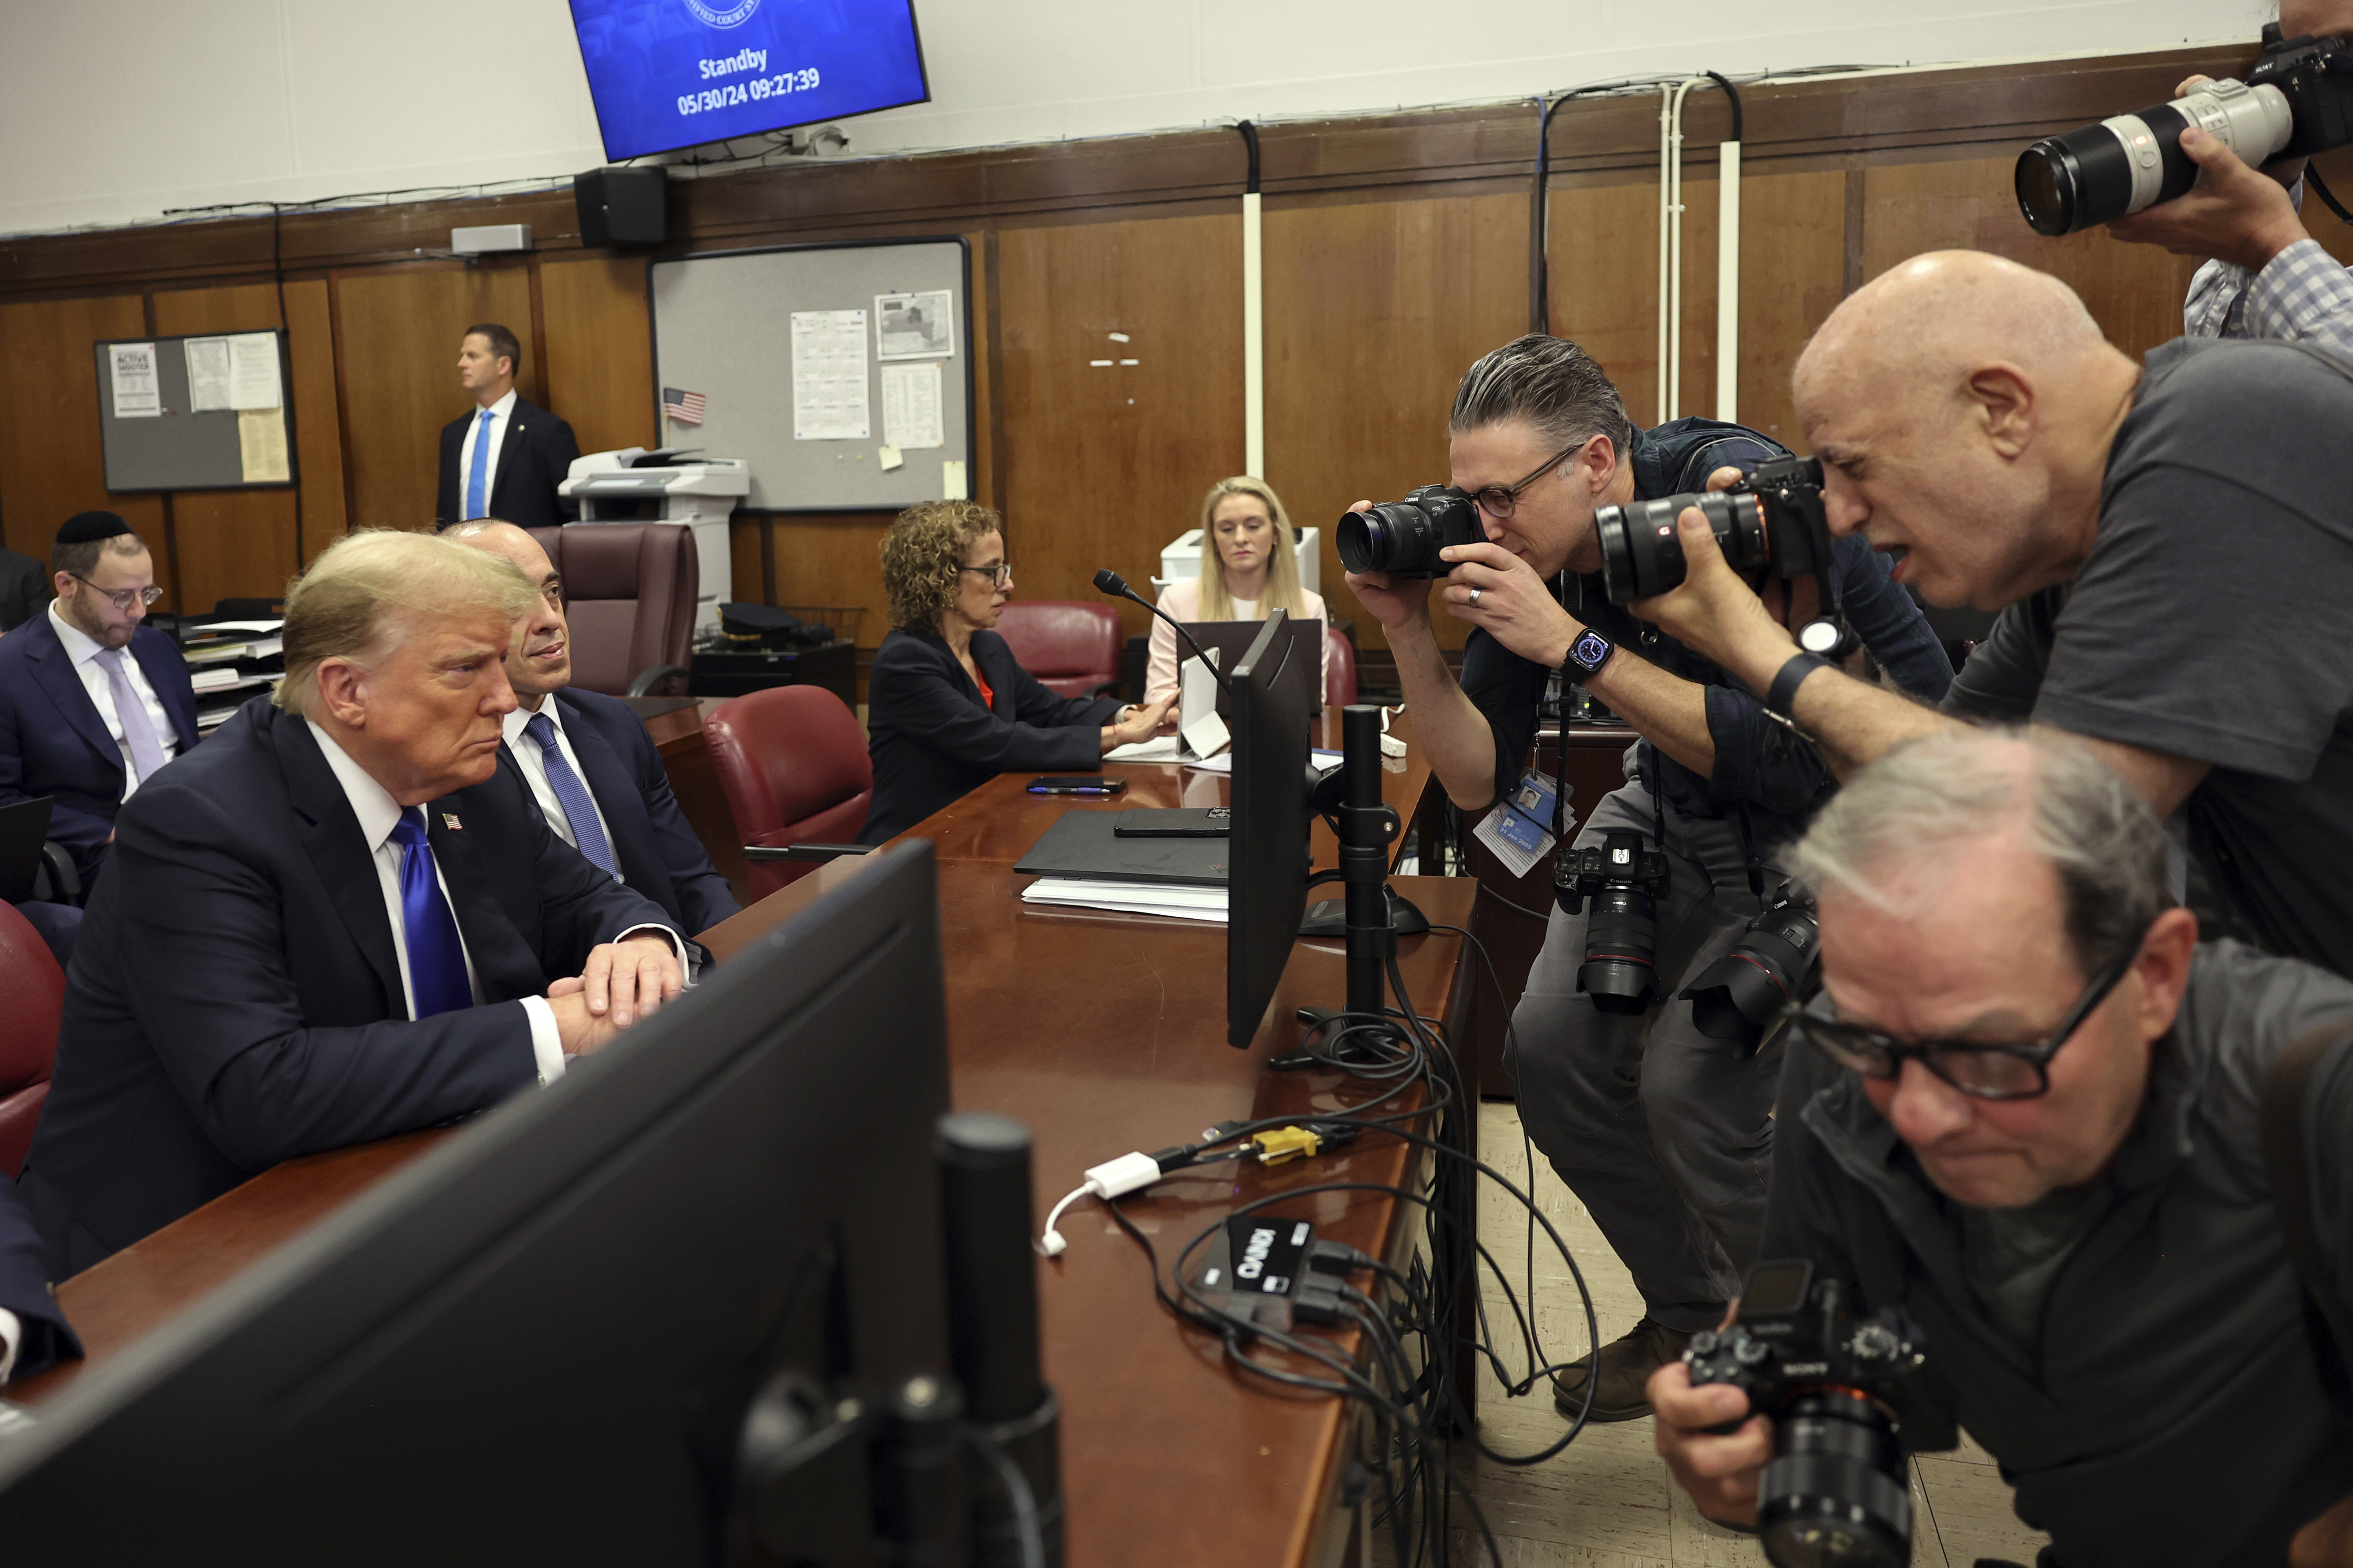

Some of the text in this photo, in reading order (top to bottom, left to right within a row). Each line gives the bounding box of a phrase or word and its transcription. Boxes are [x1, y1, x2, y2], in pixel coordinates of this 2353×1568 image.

[698, 47, 767, 79] Standby
[677, 67, 820, 116] 05/30/24 09:27:39
[1503, 817, 1515, 827] P
[1518, 839, 1532, 850] 2025
[1774, 899, 1788, 910] Canon
